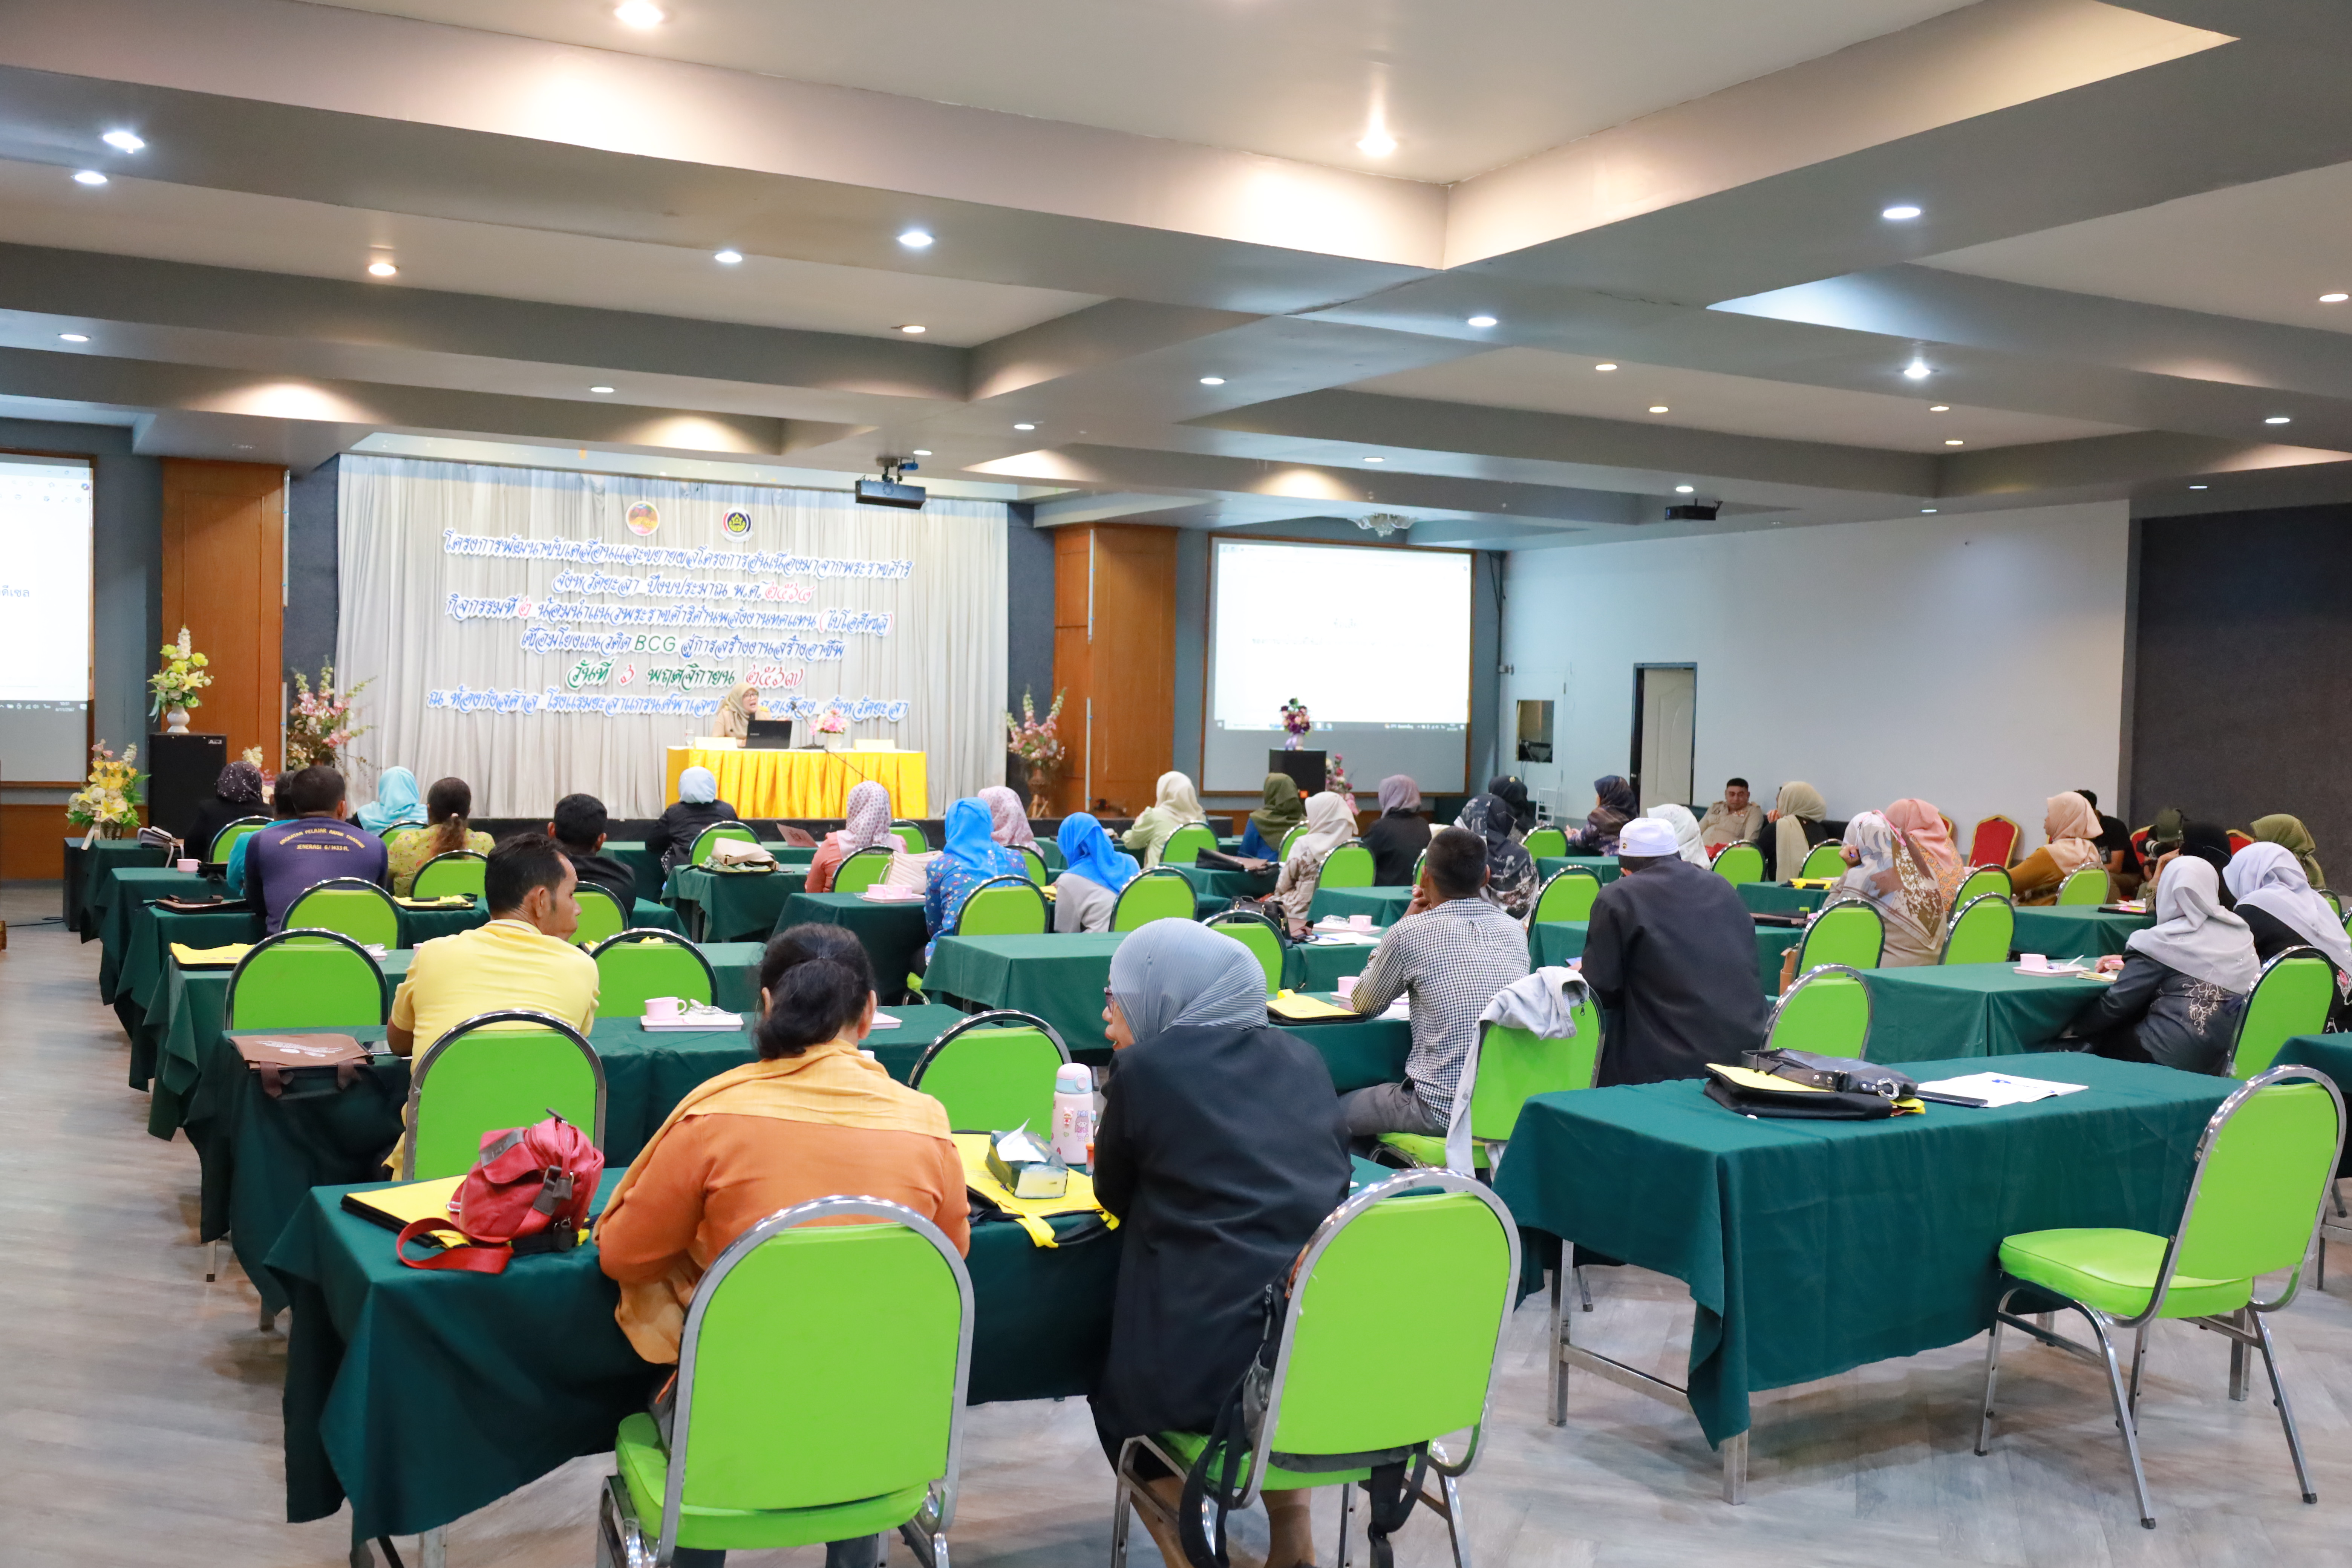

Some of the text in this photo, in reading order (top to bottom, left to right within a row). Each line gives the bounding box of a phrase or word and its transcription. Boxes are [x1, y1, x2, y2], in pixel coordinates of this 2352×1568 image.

[444, 529, 913, 578] โครงการพัฒนาขับเคลื่อนและขยายผลโครงการอันเนื่องมาจากพระราชดำริ
[0, 585, 30, 597] ดีเซล
[553, 569, 640, 596] จังหวัดยะลา
[648, 573, 728, 597] ปีงบประมาณ
[446, 593, 521, 619] กิจกรรมที่
[538, 597, 816, 628] น้อมนำแนวพระราชดำริด้านพลังงานทดแทน
[521, 624, 846, 662] เชื่อมโยงแนวคิด BCG สู่การสร้างงานสร้างอาชีพ
[567, 658, 804, 691] วันที่ ๖ พฤศจิกายน ๒๕๖๗
[429, 691, 444, 706] ณ
[279, 831, 303, 845] ANGKATAN
